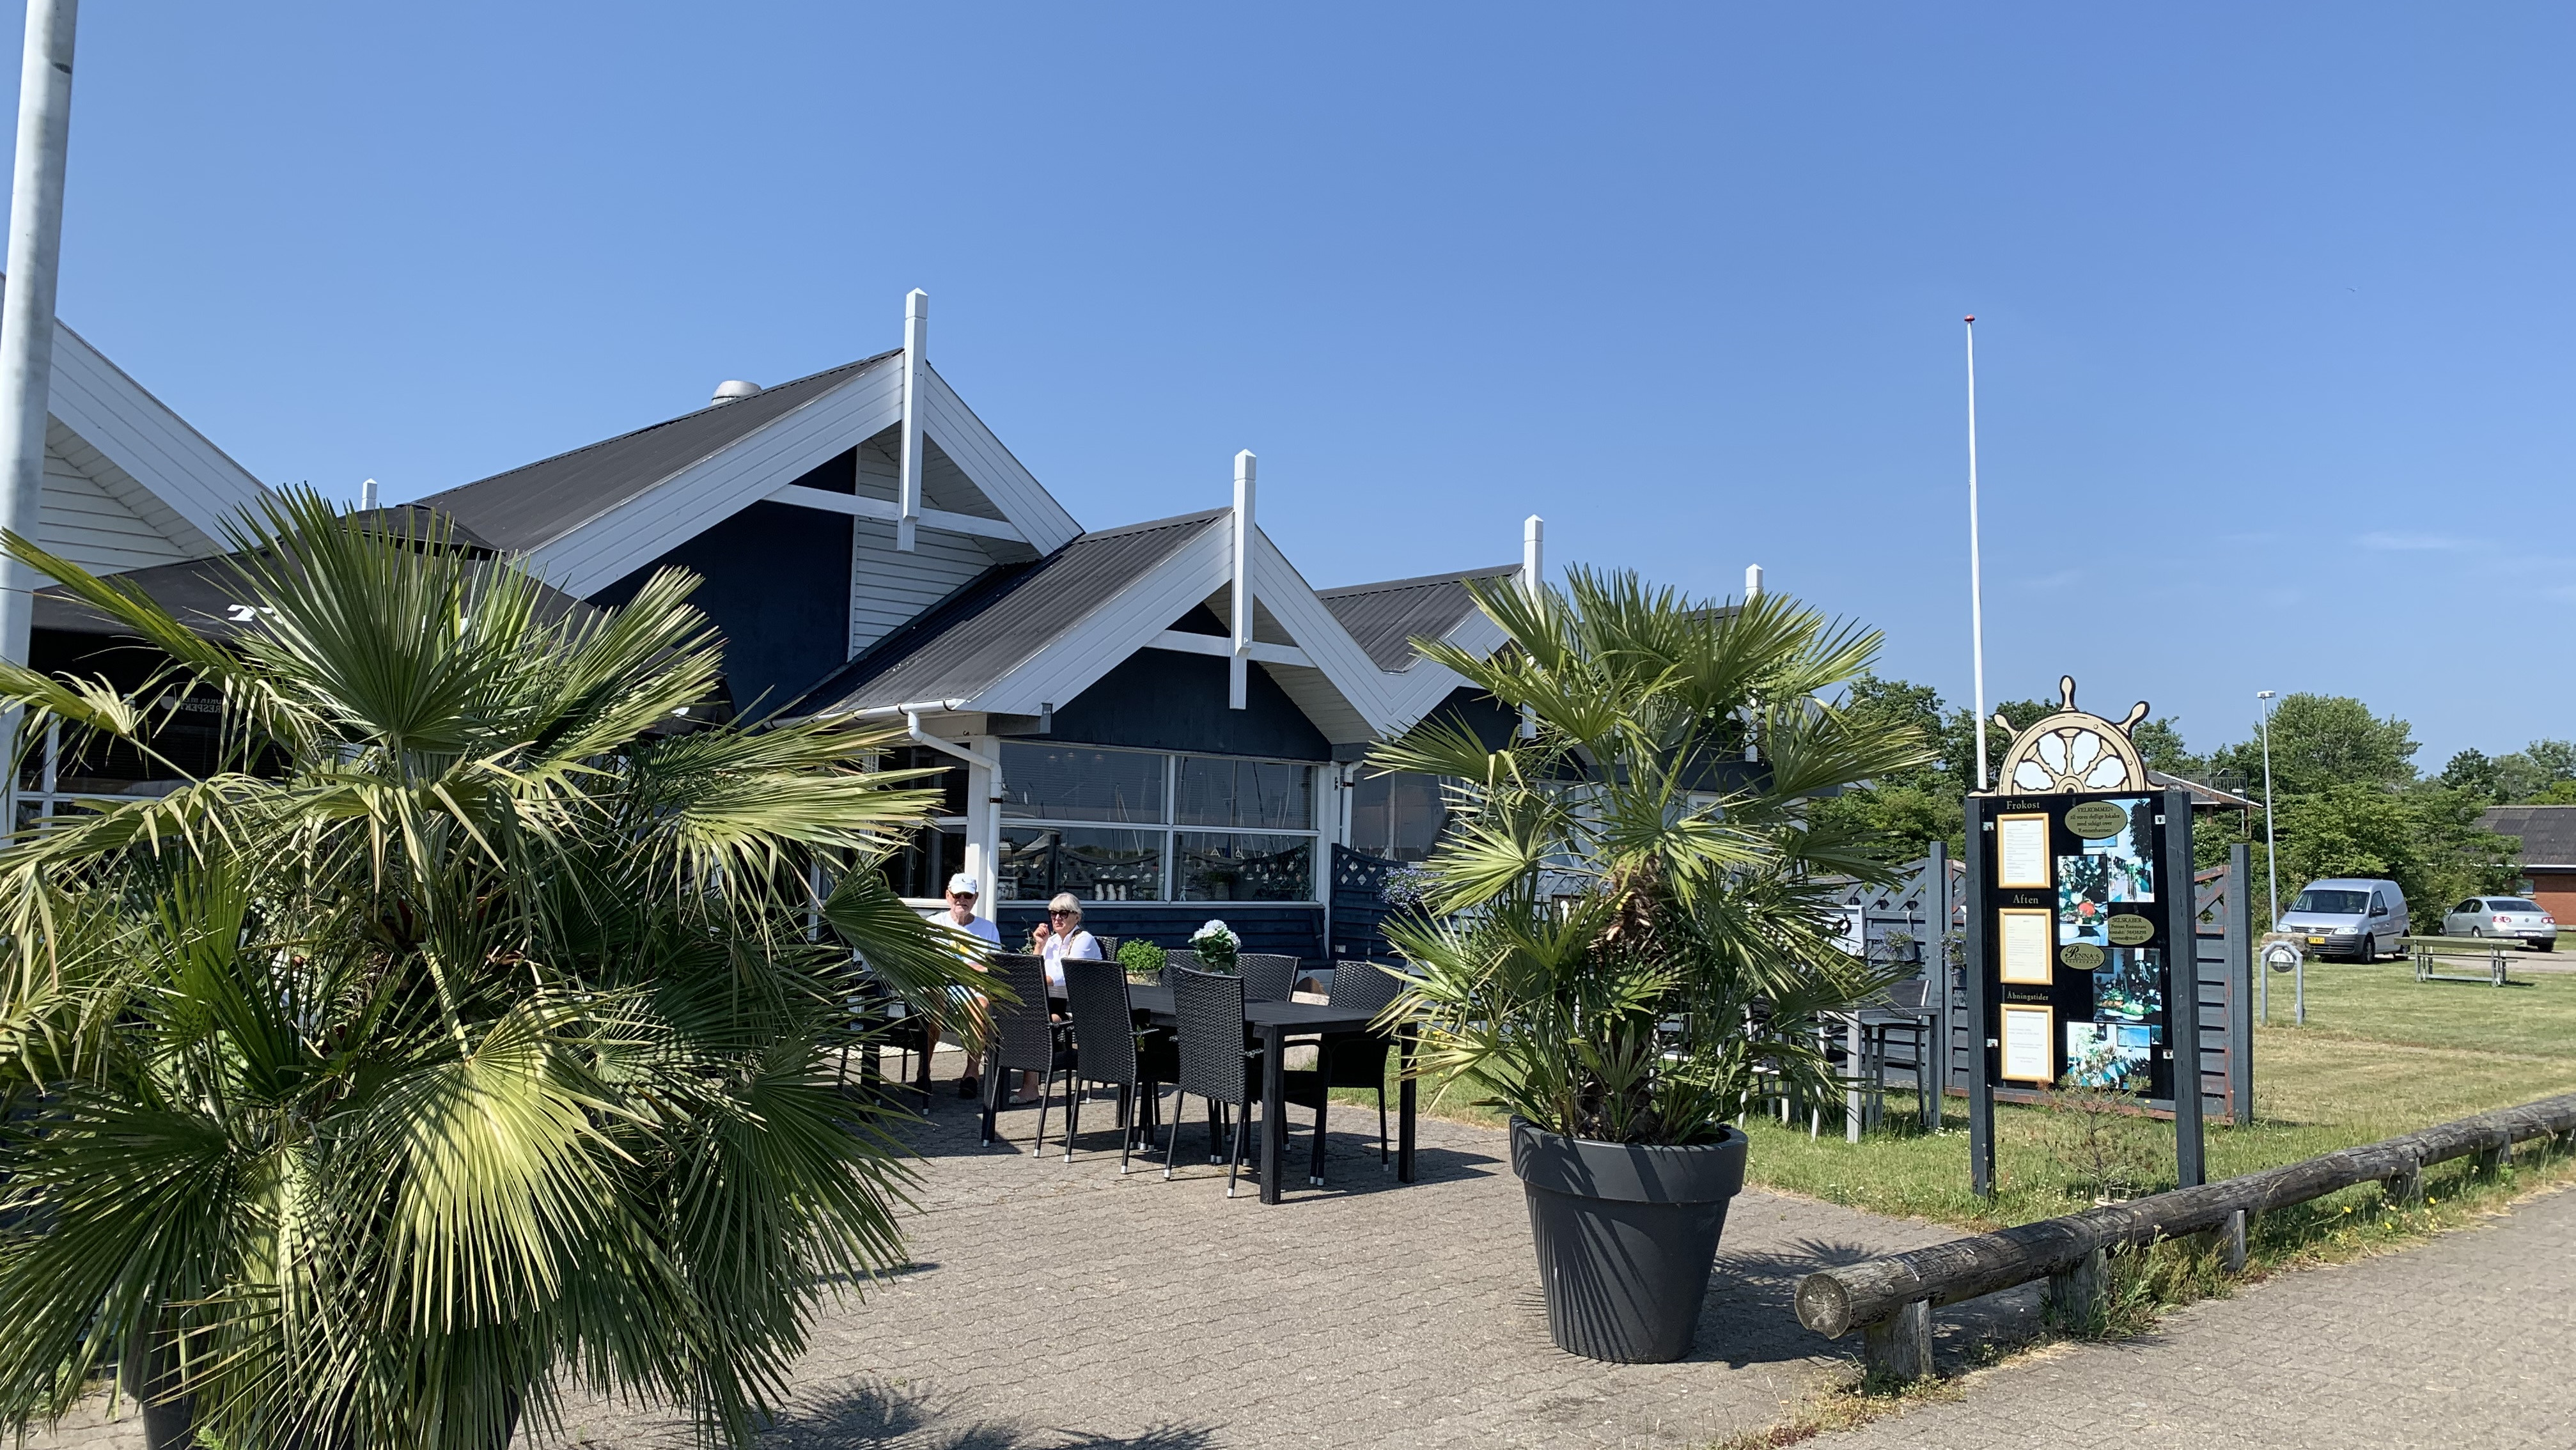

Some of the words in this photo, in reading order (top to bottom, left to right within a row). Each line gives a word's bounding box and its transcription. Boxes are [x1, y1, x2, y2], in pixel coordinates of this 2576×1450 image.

[2006, 800, 2040, 809] Frokost
[2012, 894, 2039, 904] Aften
[2007, 990, 2049, 1001] Åbningstider
